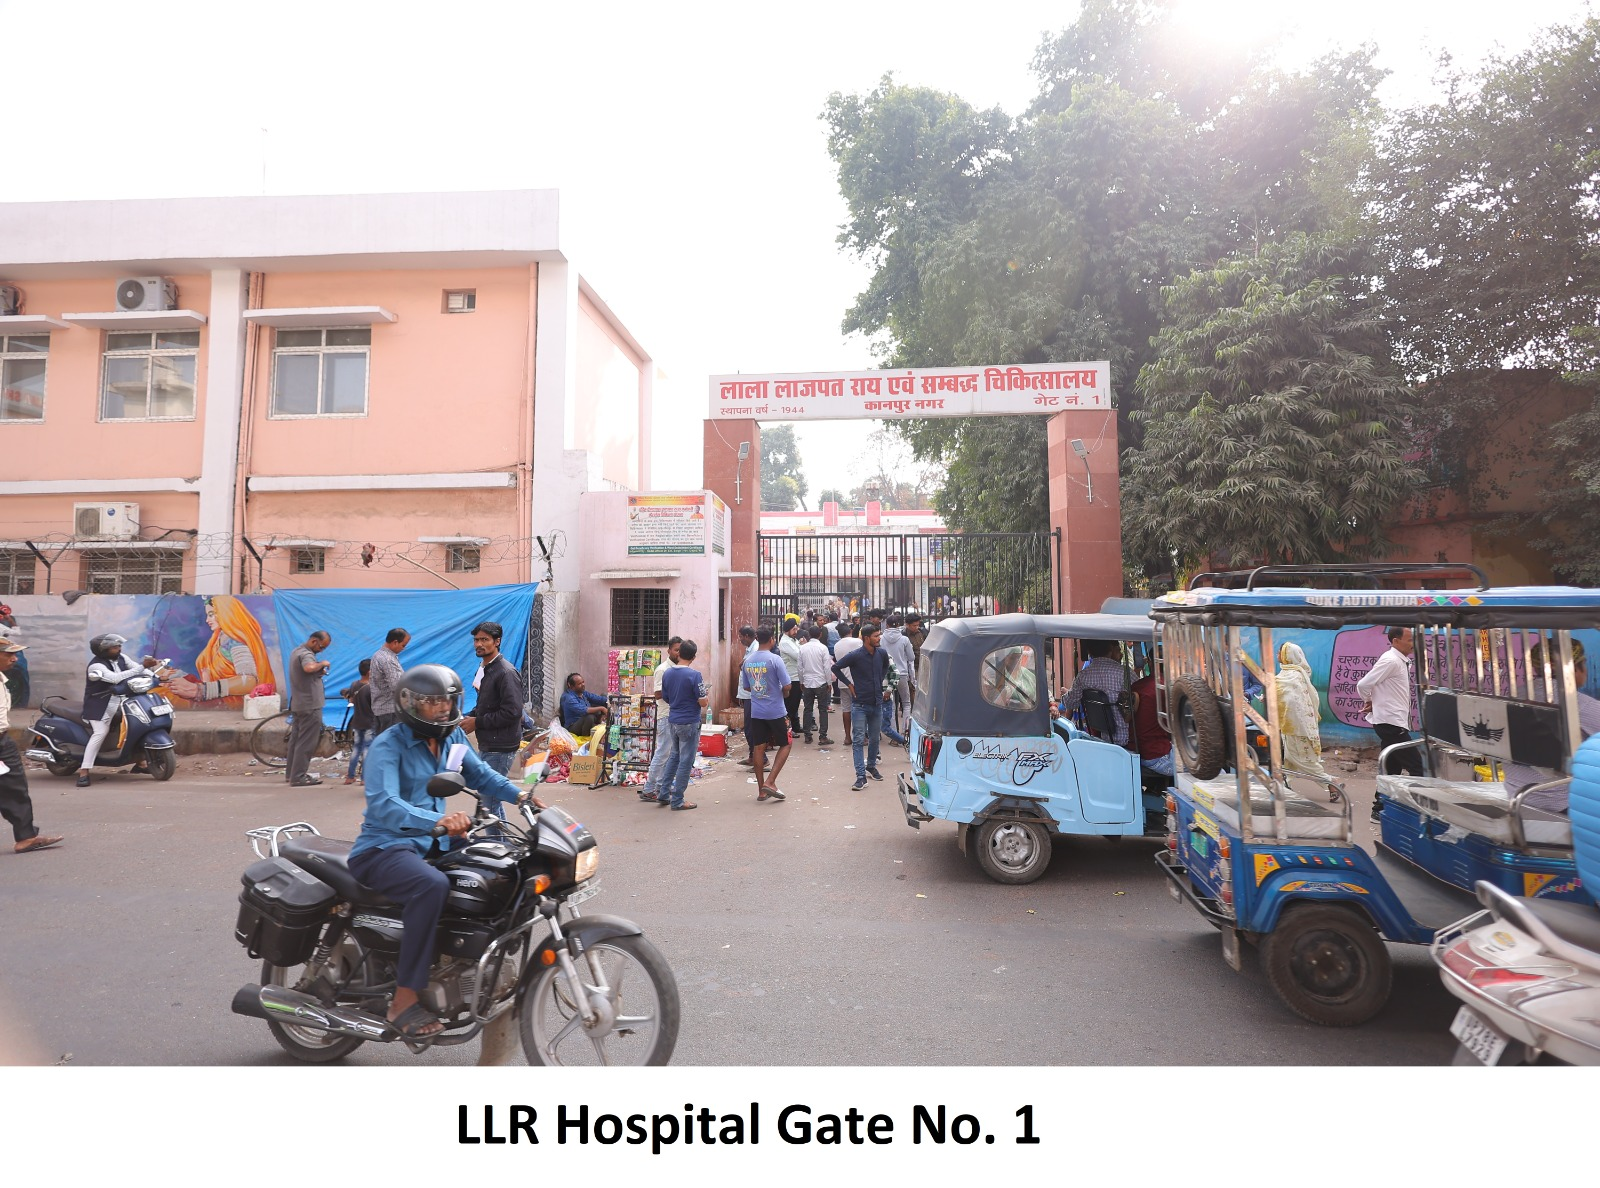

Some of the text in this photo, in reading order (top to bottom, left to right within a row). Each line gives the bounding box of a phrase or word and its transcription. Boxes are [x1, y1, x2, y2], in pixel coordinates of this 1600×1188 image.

[720, 366, 1098, 400] लाला लाजपत राय एवं सम्बद्ध चिकित्सालय
[1034, 393, 1060, 407] गेट
[1092, 395, 1100, 406] 1
[720, 407, 752, 416] स्थापना
[755, 404, 769, 415] वर्ष
[781, 406, 805, 414] 1944
[864, 399, 945, 414] कानपुर नगर
[1343, 595, 1378, 606] AUTO
[1380, 595, 1418, 606] INDIA
[1338, 656, 1377, 667] चरक एक
[1350, 669, 1370, 681] कुष
[1347, 697, 1365, 709] उल्ल
[1017, 751, 1054, 761] FX
[573, 762, 595, 771] Bisleri
